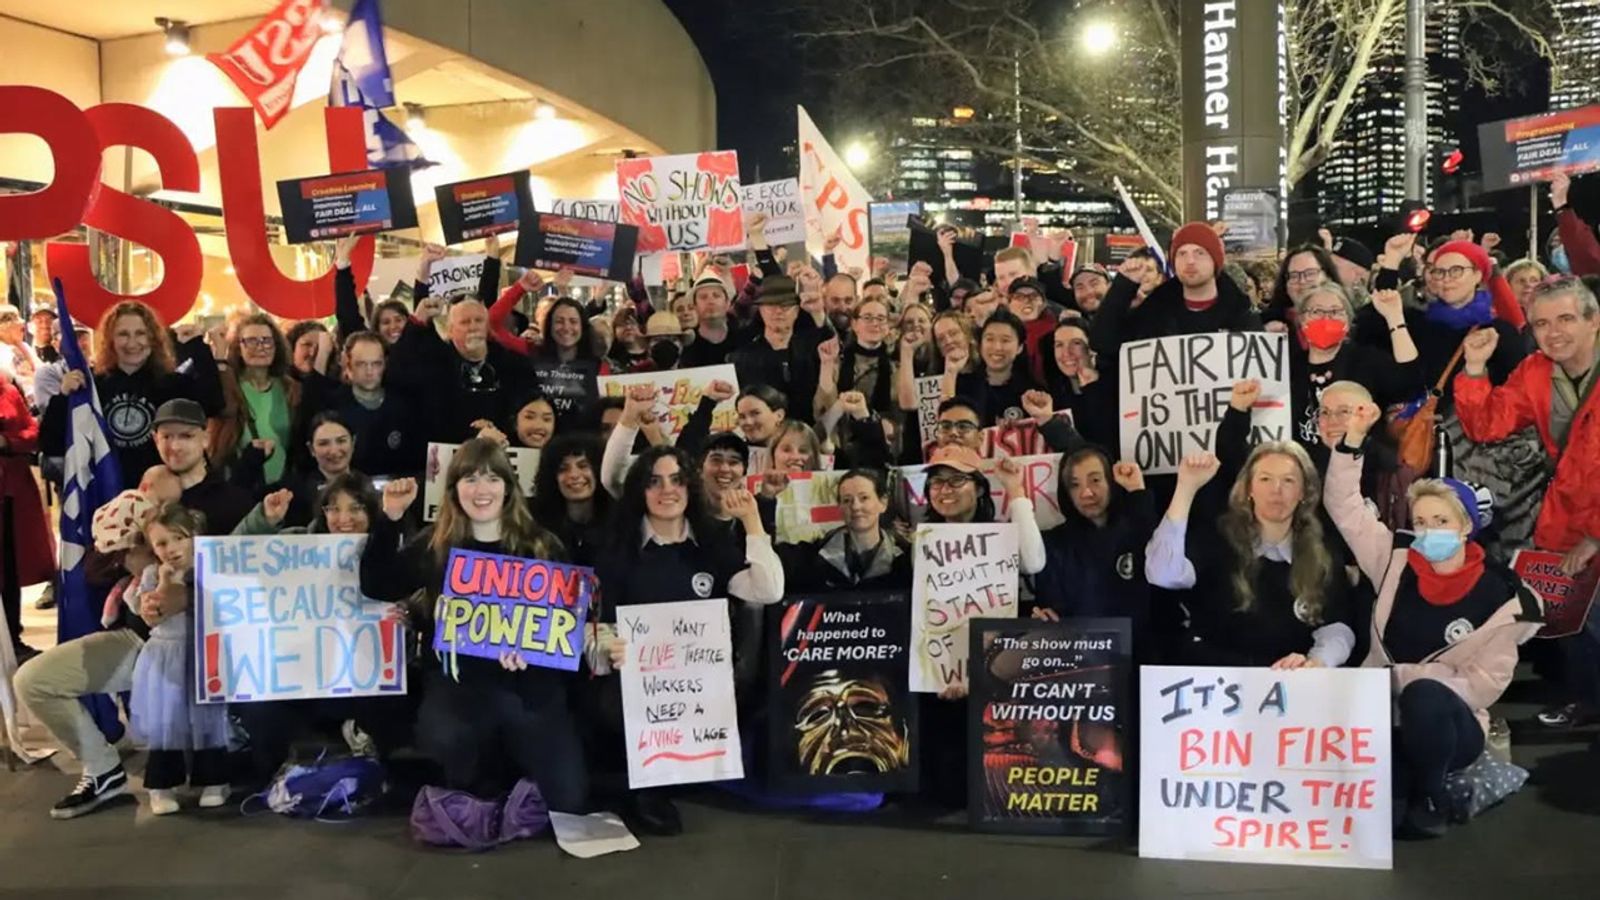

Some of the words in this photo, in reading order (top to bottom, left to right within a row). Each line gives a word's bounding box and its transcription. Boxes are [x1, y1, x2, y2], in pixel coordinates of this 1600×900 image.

[1203, 1, 1237, 130] Hamer
[623, 173, 661, 207] NO
[668, 169, 740, 209] SHOWS
[759, 180, 794, 200] EXEC
[647, 203, 707, 224] WITHOUT
[667, 221, 700, 246] US
[429, 262, 484, 288] STRONGE
[551, 369, 585, 381] Theatre
[1126, 335, 1219, 394] FAIR
[1226, 332, 1284, 382] PAY
[920, 394, 941, 411] ST
[1140, 392, 1171, 428] IS
[1175, 386, 1235, 426] THE
[201, 540, 260, 575] THE
[922, 532, 1000, 568] WHAT
[450, 554, 580, 608] UNION
[926, 562, 990, 592] ABOUT
[212, 582, 382, 628] BECAUSE
[823, 610, 861, 624] What
[926, 583, 1013, 627] STATE
[442, 597, 575, 657] POWER
[672, 615, 709, 637] WANT
[796, 626, 869, 643] happened
[871, 627, 887, 639] to
[638, 642, 677, 667] LIVE
[927, 633, 954, 658] OF
[1031, 637, 1072, 650] show
[1073, 637, 1113, 650] must
[1021, 656, 1041, 670] go
[642, 675, 704, 697] WORKERS
[1011, 682, 1030, 699] IT
[1032, 682, 1096, 699] CAN'T
[646, 701, 687, 723] NEED
[694, 702, 704, 716] A
[1159, 676, 1242, 724] IT'S
[1257, 680, 1287, 716] A
[991, 704, 1086, 721] WITHOUT
[1087, 705, 1116, 722] US
[638, 728, 685, 752] LIVING
[692, 726, 729, 744] WAGE
[1179, 728, 1253, 772] BIN
[1276, 726, 1377, 768] FIRE
[1007, 766, 1100, 787] PEOPLE
[1006, 792, 1099, 813] MATTER
[1160, 777, 1292, 814] UNDER
[1301, 779, 1377, 810] THE
[1211, 815, 1353, 851] SPIRE!
